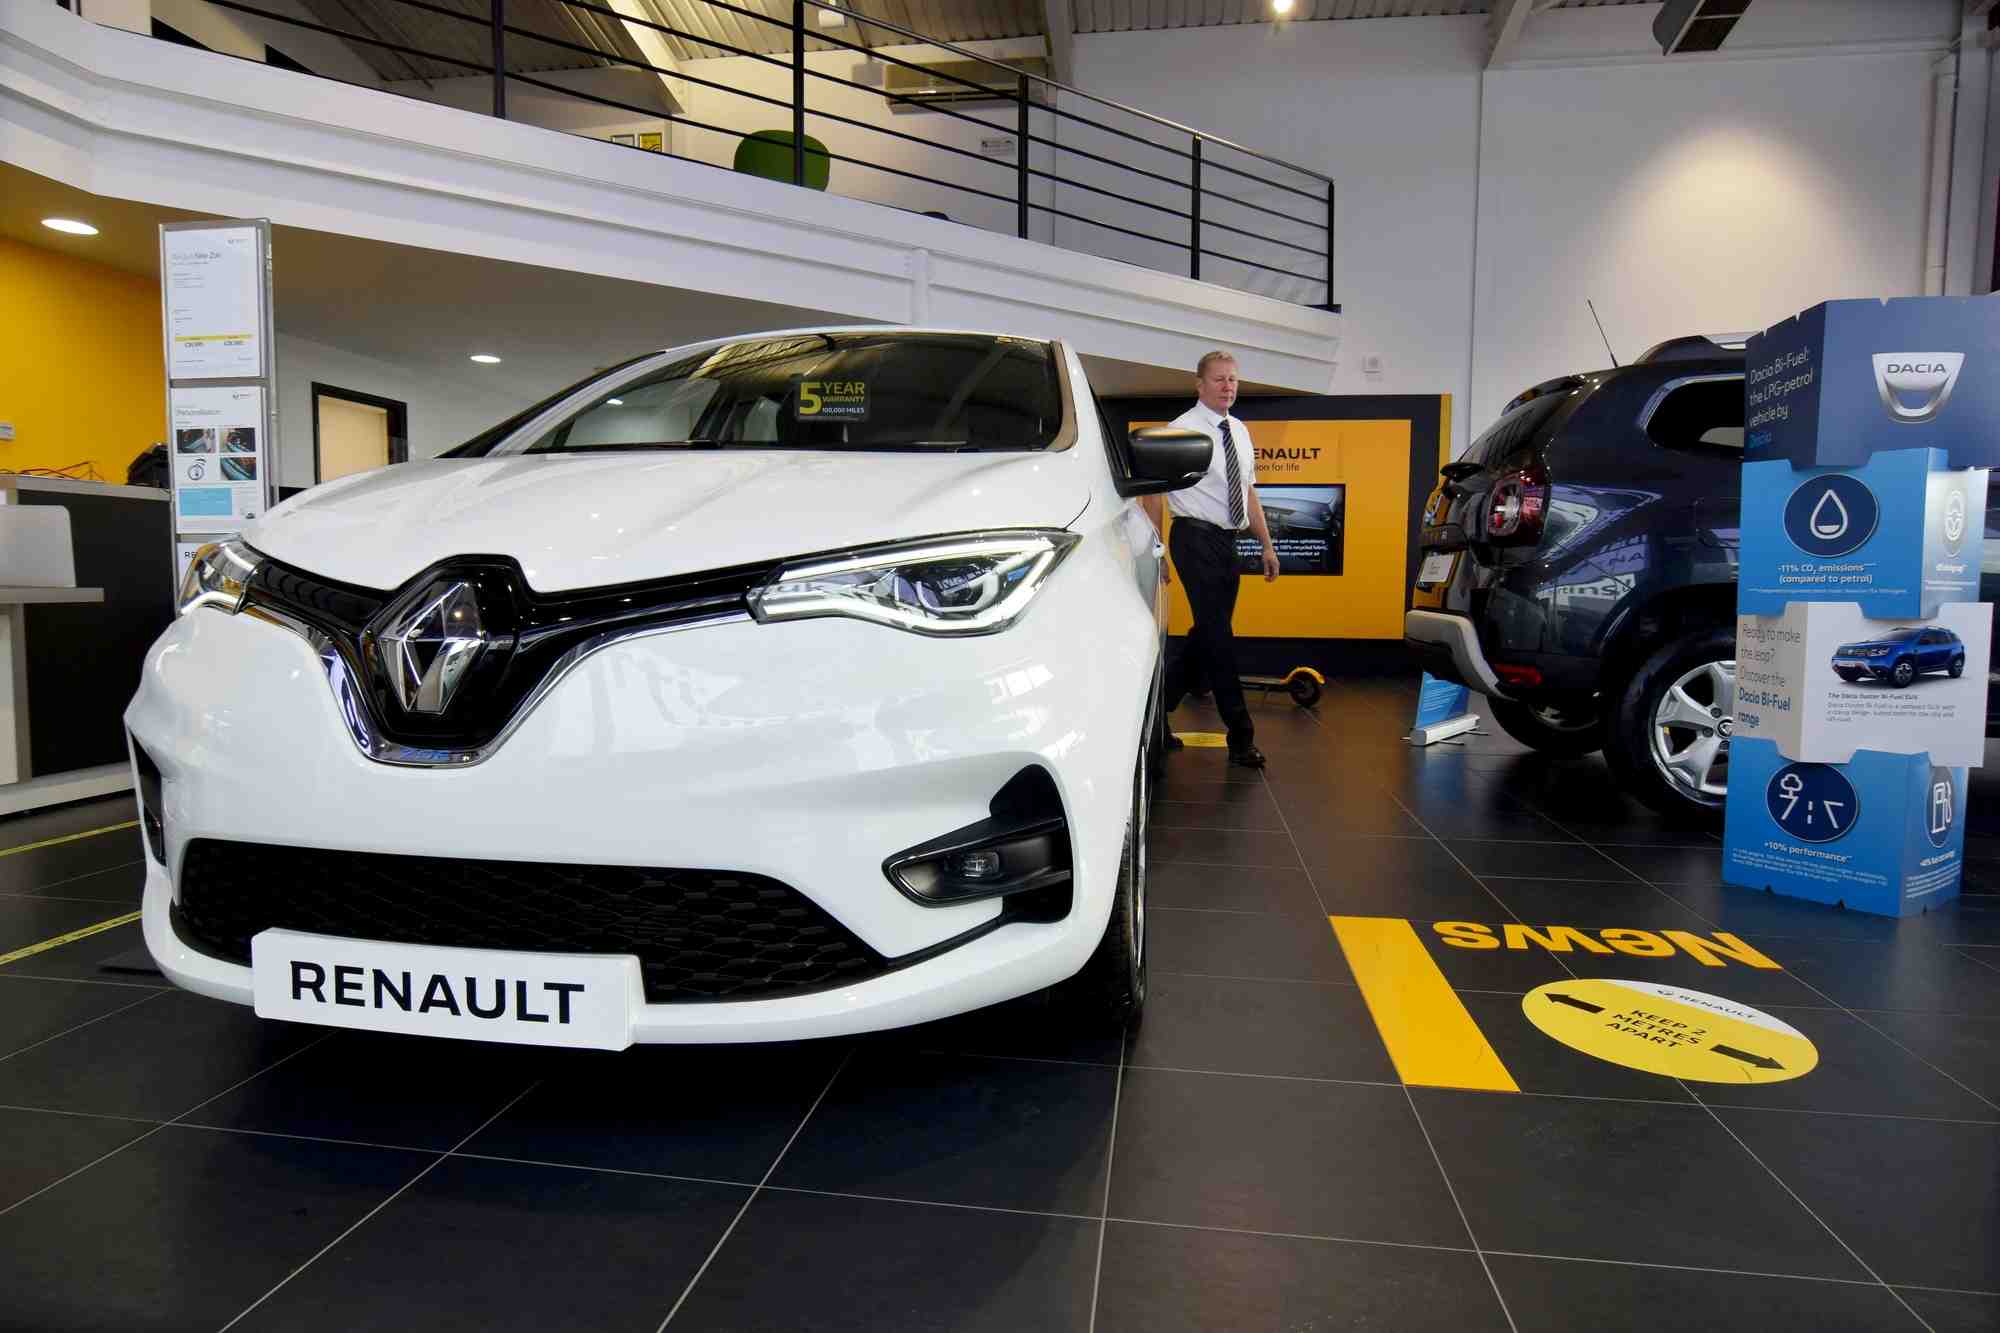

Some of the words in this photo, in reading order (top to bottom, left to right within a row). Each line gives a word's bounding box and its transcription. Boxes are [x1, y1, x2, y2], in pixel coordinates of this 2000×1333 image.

[1750, 364, 1773, 384] Dacia
[1887, 364, 1946, 373] DACIA
[823, 382, 865, 394] YEAR
[1749, 387, 1763, 405] the
[1764, 368, 1813, 401] LPG-petrol
[799, 382, 822, 415] 5
[822, 395, 865, 403] WARRANTY
[822, 407, 845, 415] 100,000
[1777, 402, 1788, 420] by
[1253, 448, 1321, 460] ENAULT
[1272, 463, 1283, 472] for
[1286, 463, 1300, 472] life
[1778, 564, 1799, 572] -11%
[1779, 575, 1826, 584] (compared
[1828, 575, 1839, 583] to
[1840, 575, 1873, 584] petrol)
[1767, 629, 1776, 640] to
[1776, 628, 1801, 643] make
[1739, 687, 1760, 704] Dacia
[1761, 691, 1791, 711] Bi-Fuel
[1738, 711, 1760, 728] range
[1789, 845, 1849, 864] performance
[290, 960, 585, 1025] RENAULT
[1679, 995, 1757, 1019] RENAULT
[1631, 1010, 1688, 1029] KEEP
[1606, 1023, 1682, 1048] APART
[1612, 1014, 1702, 1044] METRES
